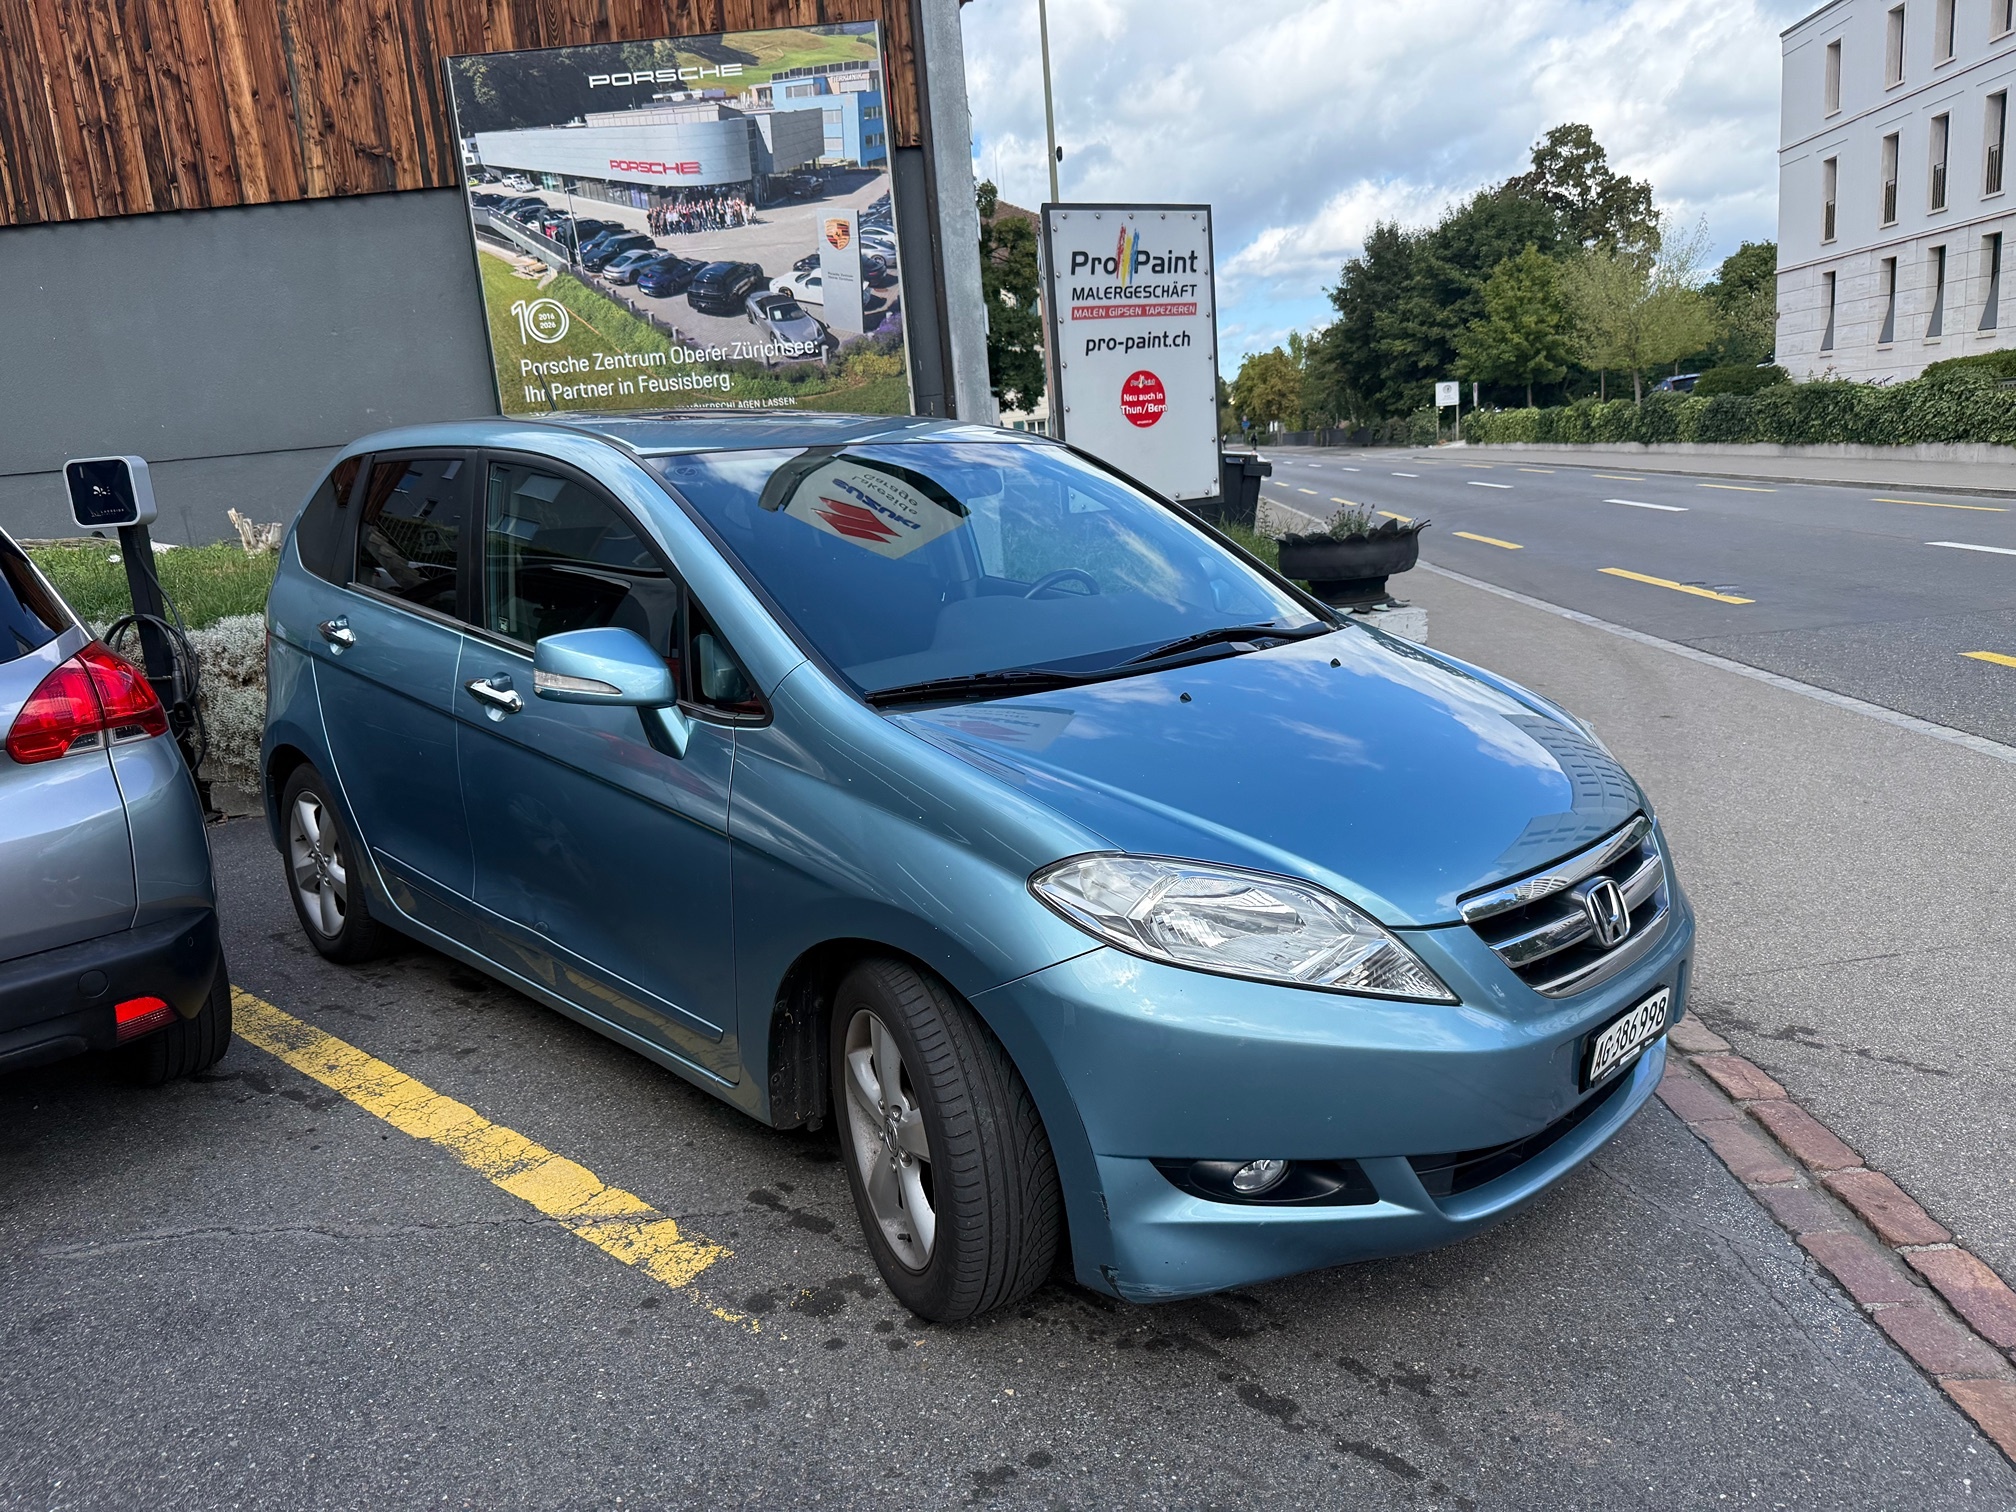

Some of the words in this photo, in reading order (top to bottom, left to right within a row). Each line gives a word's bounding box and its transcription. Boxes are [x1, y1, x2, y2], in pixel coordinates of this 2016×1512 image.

[588, 63, 743, 89] PORSCHE
[609, 160, 702, 175] PORSCHE
[1133, 249, 1198, 275] Paint
[1071, 281, 1198, 301] MALERGESCHÄFT
[538, 313, 555, 321] 2016
[1073, 307, 1106, 318] MALEN
[1109, 305, 1142, 317] GIPSEN
[1145, 304, 1196, 316] TAPEZIEREN
[540, 321, 557, 329] 2026
[1085, 330, 1191, 357] pro-paint.ch
[520, 355, 590, 377] Porsche
[592, 351, 667, 371] Zentrum
[670, 345, 728, 364] Oberer
[731, 338, 820, 360] Zürichsee:
[524, 385, 546, 402] Ihr
[551, 382, 615, 400] Partner
[618, 377, 634, 395] in
[638, 371, 735, 393] Feusisberg.
[762, 396, 798, 408] LASSEN.
[1123, 393, 1138, 402] Neu
[1139, 392, 1156, 401] auch
[1156, 391, 1164, 400] in
[1120, 402, 1168, 415] Thun/Bern
